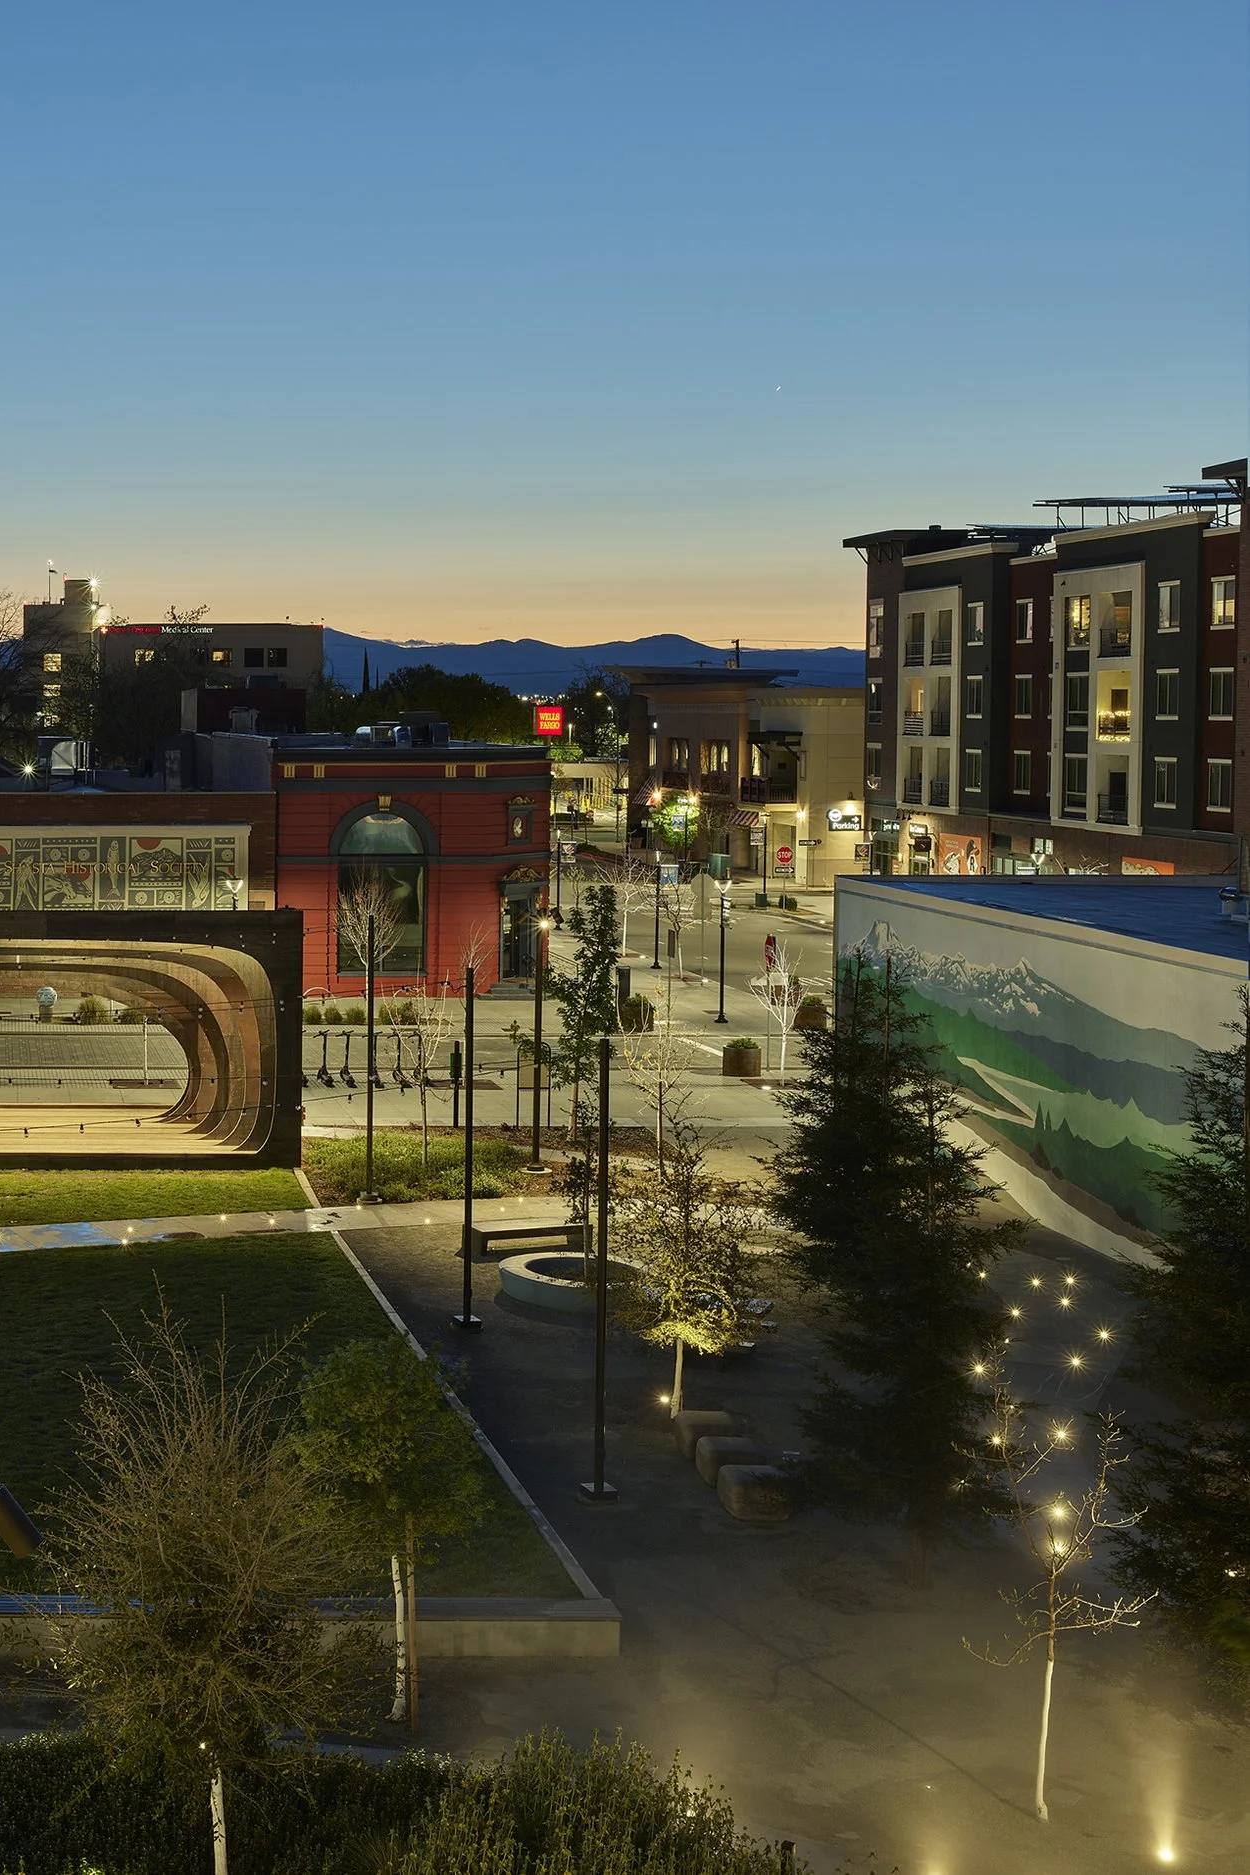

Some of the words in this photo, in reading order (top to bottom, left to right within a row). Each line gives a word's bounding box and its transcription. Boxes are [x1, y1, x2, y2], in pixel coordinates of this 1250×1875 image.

[161, 626, 189, 634] Medical
[190, 626, 214, 634] Center
[539, 713, 560, 721] WELLS
[539, 722, 560, 730] FARGO
[832, 823, 859, 831] Parking
[777, 851, 793, 859] STOP
